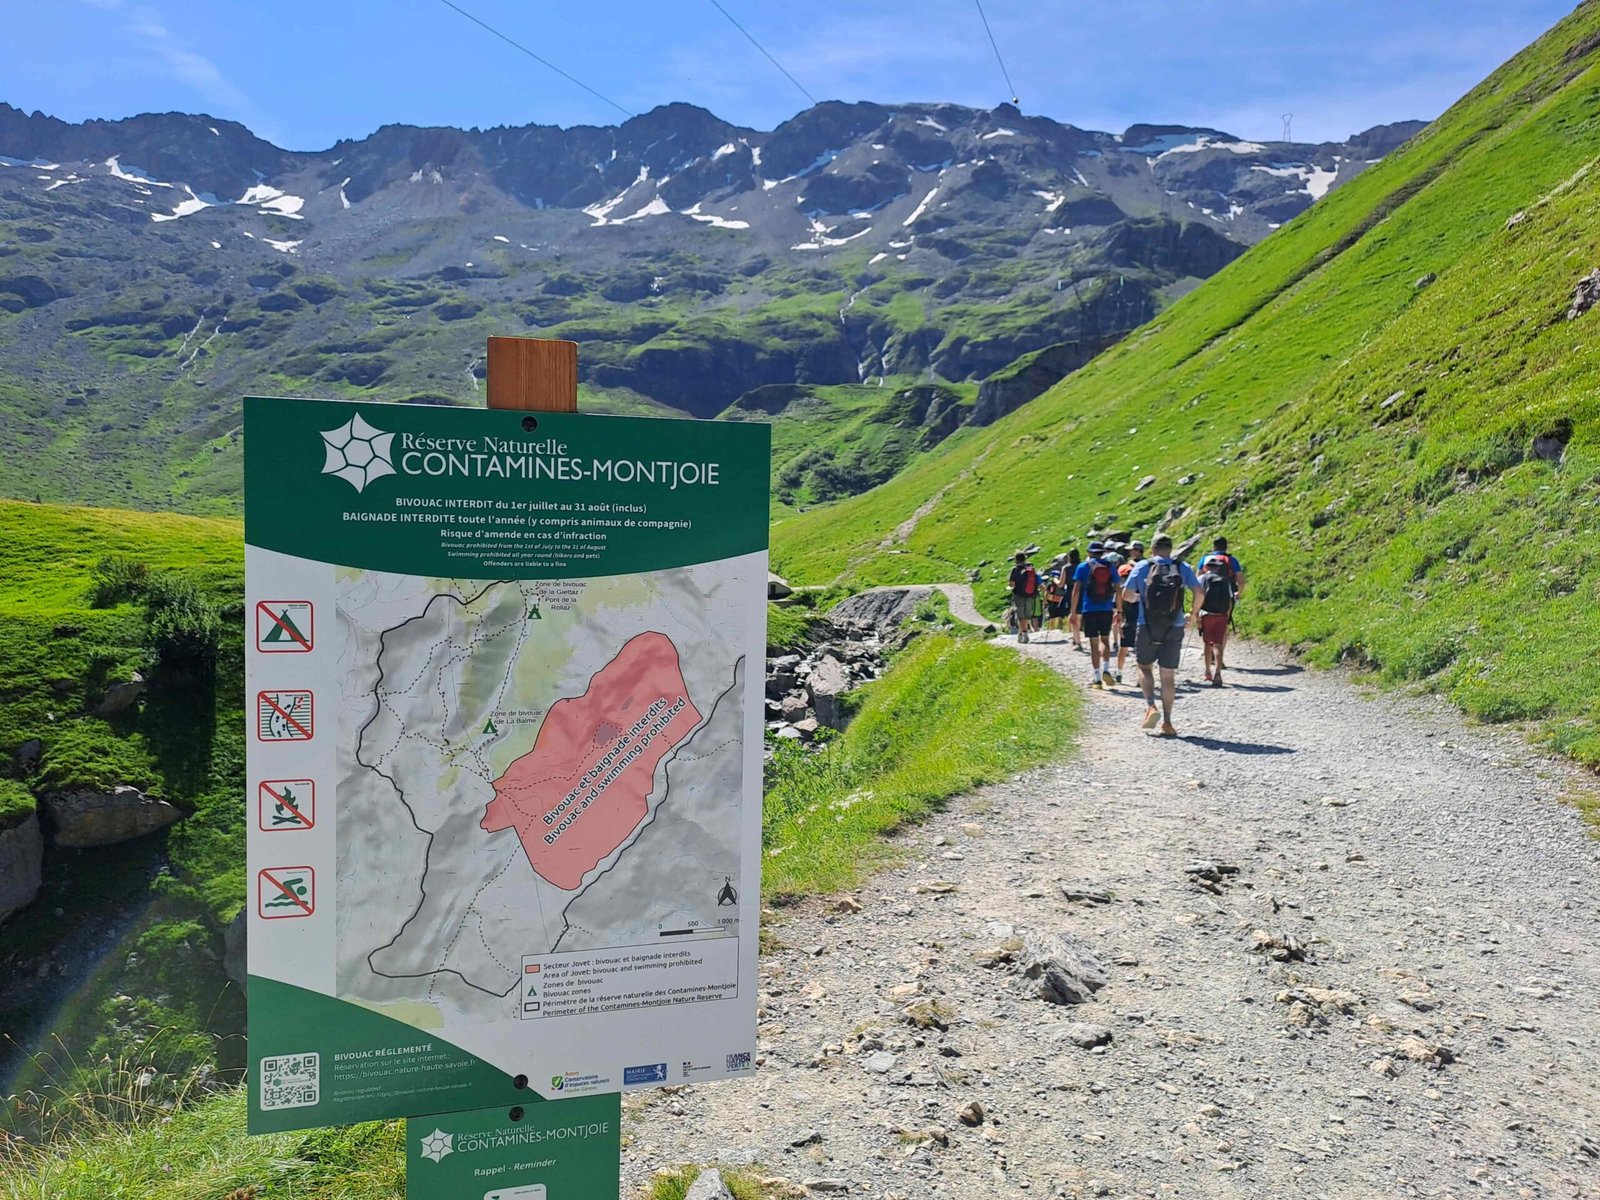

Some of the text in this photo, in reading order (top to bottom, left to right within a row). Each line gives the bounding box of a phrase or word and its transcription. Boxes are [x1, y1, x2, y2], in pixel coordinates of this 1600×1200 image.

[401, 432, 568, 456] Réserve Naturelle
[401, 453, 719, 490] CONTAMINES-MONTJOIE
[396, 498, 442, 507] BIVOUAC
[445, 499, 493, 509] INTERDIT
[495, 500, 509, 509] du
[511, 501, 527, 510] 1er
[528, 502, 558, 512] juillet
[574, 503, 585, 511] 31
[588, 503, 610, 512] août
[612, 504, 647, 514] (inclus)
[342, 512, 692, 530] BAIGNADE INTERDITE toute l'année (y compris animaux de compagnie)
[440, 529, 473, 539] Risque
[475, 530, 522, 539] d'amende
[553, 531, 607, 541] d'infraction
[466, 543, 498, 551] prohibited
[543, 698, 667, 825] Bivouac et baignade interdits
[544, 697, 686, 844] Bivouac and swimming prohibited
[543, 962, 570, 970] Secteur
[571, 960, 590, 968] Jovet
[595, 957, 621, 965] bivouac
[631, 953, 662, 962] baignade
[633, 962, 667, 970] swimming
[668, 959, 703, 968] prohibited
[543, 990, 570, 998] Bivouac
[543, 999, 577, 1007] Périmètre
[596, 994, 621, 1002] réserve
[623, 991, 653, 999] naturelle
[667, 982, 736, 995] Contamines-Montjoie
[543, 1007, 577, 1016] Perimeter
[600, 997, 671, 1011] Contamines-Montjoie
[673, 995, 695, 1003] Nature
[696, 993, 722, 1001] Reserve
[334, 1043, 432, 1061] BIVOUAC RÉGLEMENTÉ
[334, 1061, 379, 1071] Réservation
[393, 1056, 401, 1065] le
[402, 1055, 415, 1064] site
[417, 1053, 446, 1062] internet
[457, 1124, 535, 1141] Réserve Naturelle
[457, 1122, 609, 1153] CONTAMINES-MONTJOIE
[474, 1165, 506, 1177] Rappel
[513, 1158, 557, 1171] Reminder
